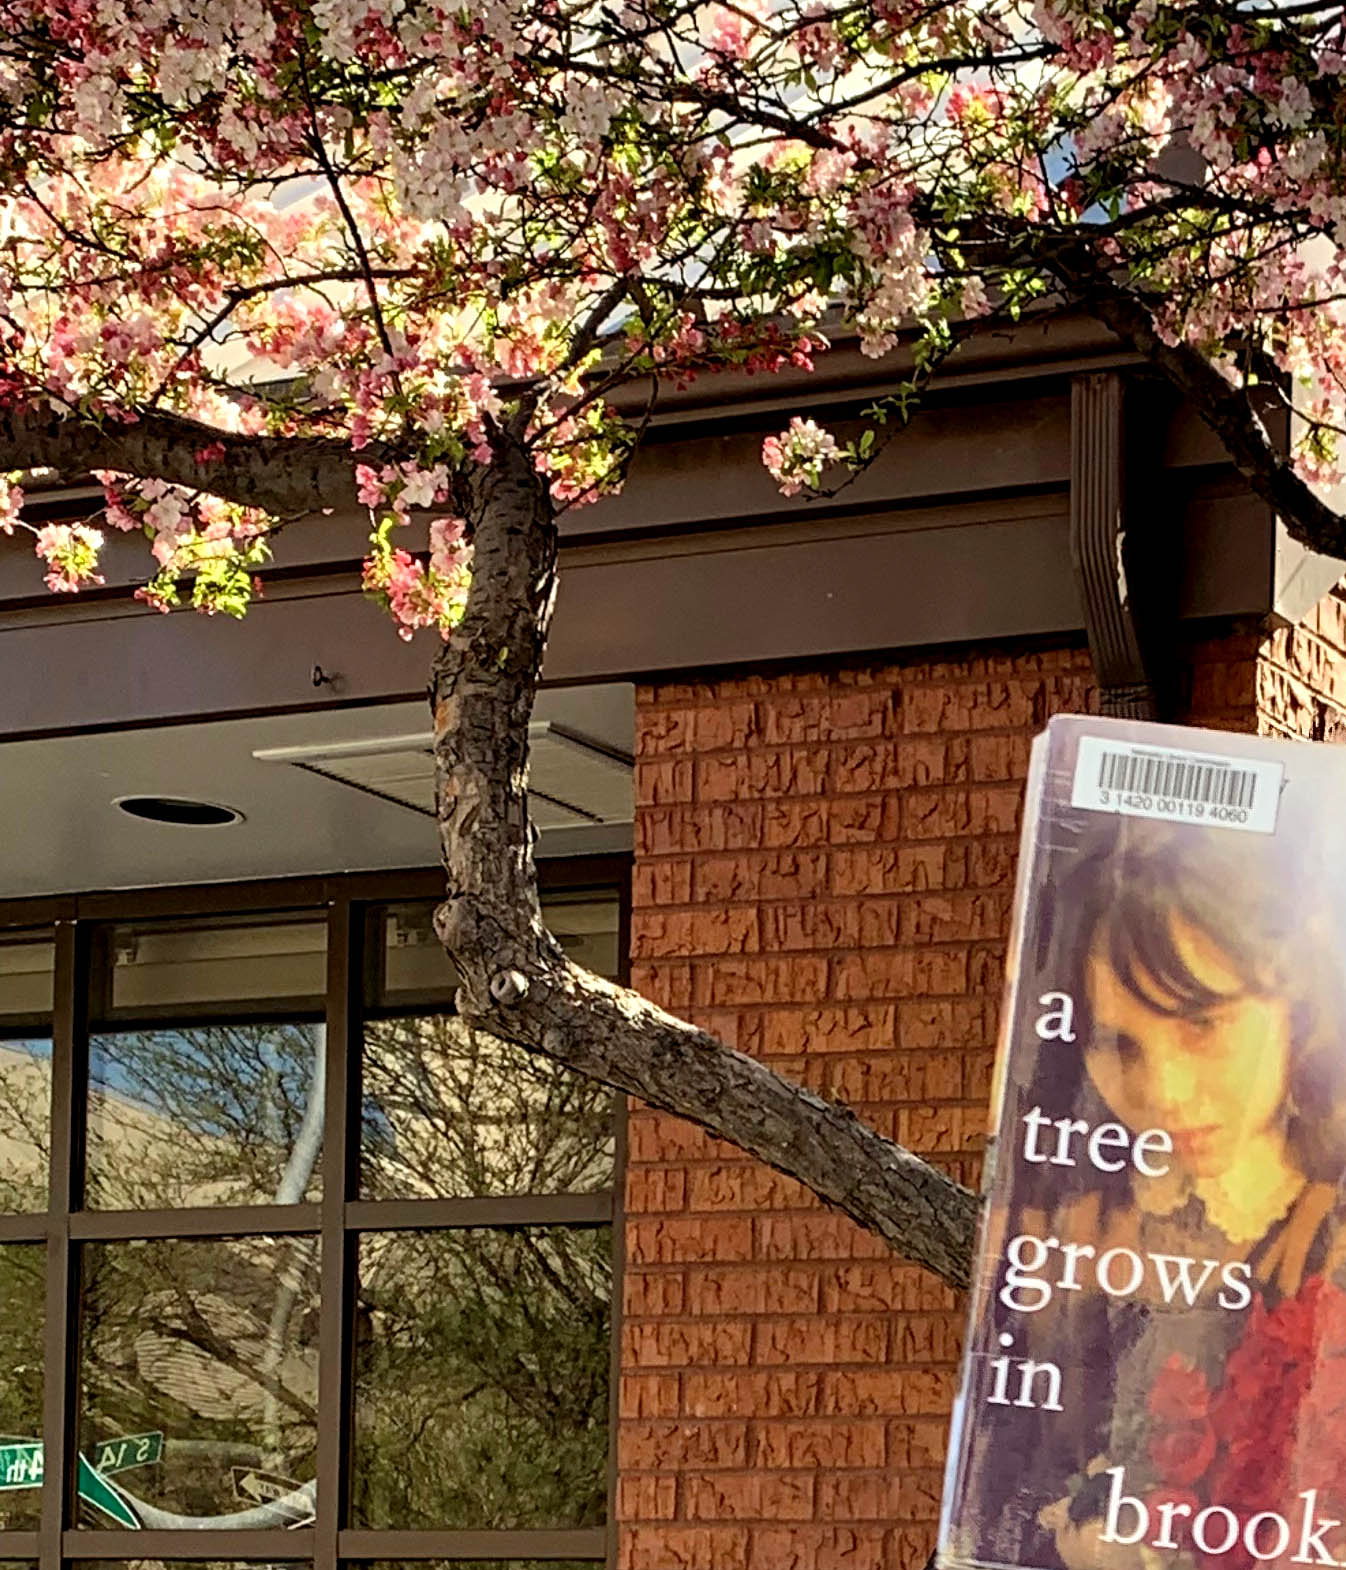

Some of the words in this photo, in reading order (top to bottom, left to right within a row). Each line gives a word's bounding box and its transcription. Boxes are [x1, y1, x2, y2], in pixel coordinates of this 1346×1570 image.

[1099, 789, 1111, 805] 3
[1116, 792, 1153, 811] 1420
[1157, 796, 1205, 818] 00119
[1208, 804, 1249, 824] 4060
[1034, 991, 1077, 1043] a
[1022, 1106, 1173, 1178] tree
[999, 1233, 1253, 1313] grows
[985, 1332, 1064, 1412] in
